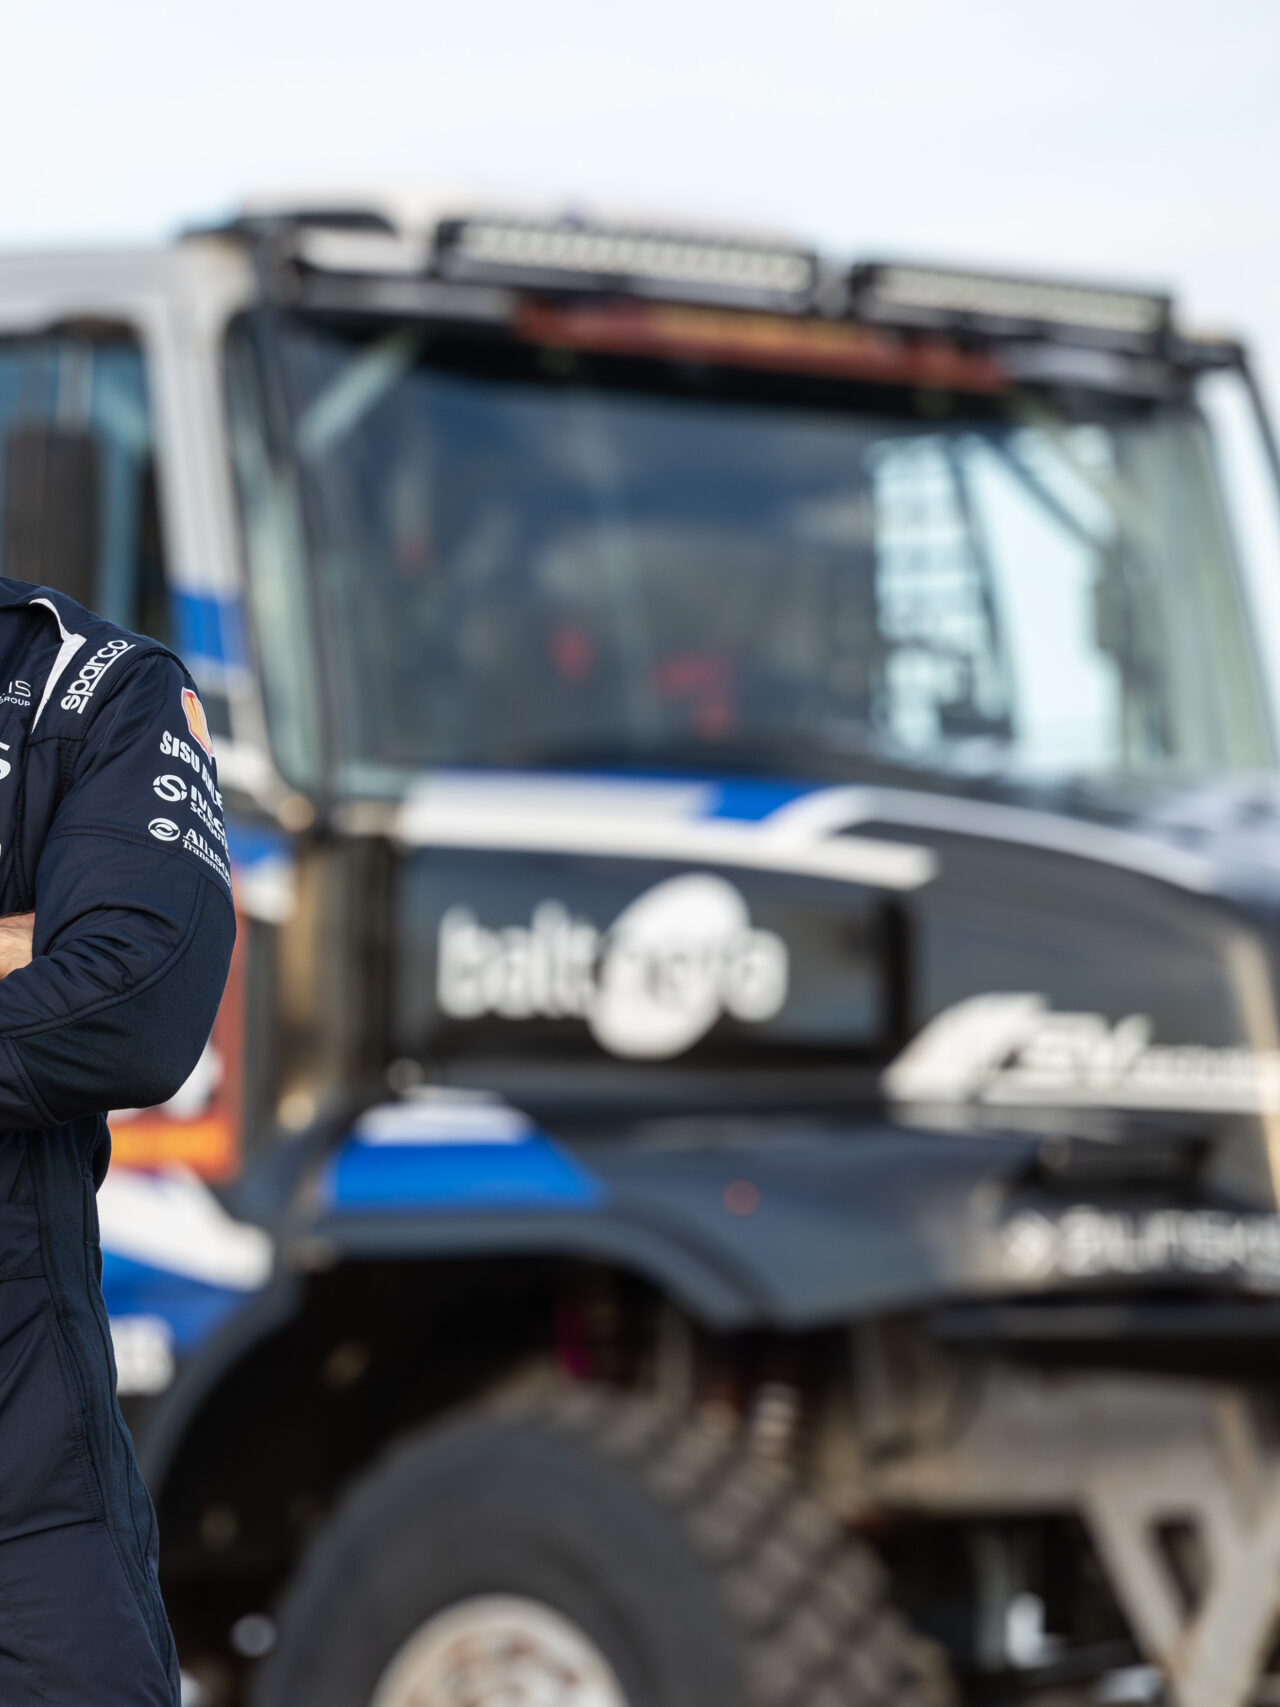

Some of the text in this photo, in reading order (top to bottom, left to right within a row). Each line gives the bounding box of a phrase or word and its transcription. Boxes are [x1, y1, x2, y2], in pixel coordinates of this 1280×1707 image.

[61, 639, 132, 712] sparco
[159, 730, 224, 813] SISU AXLE
